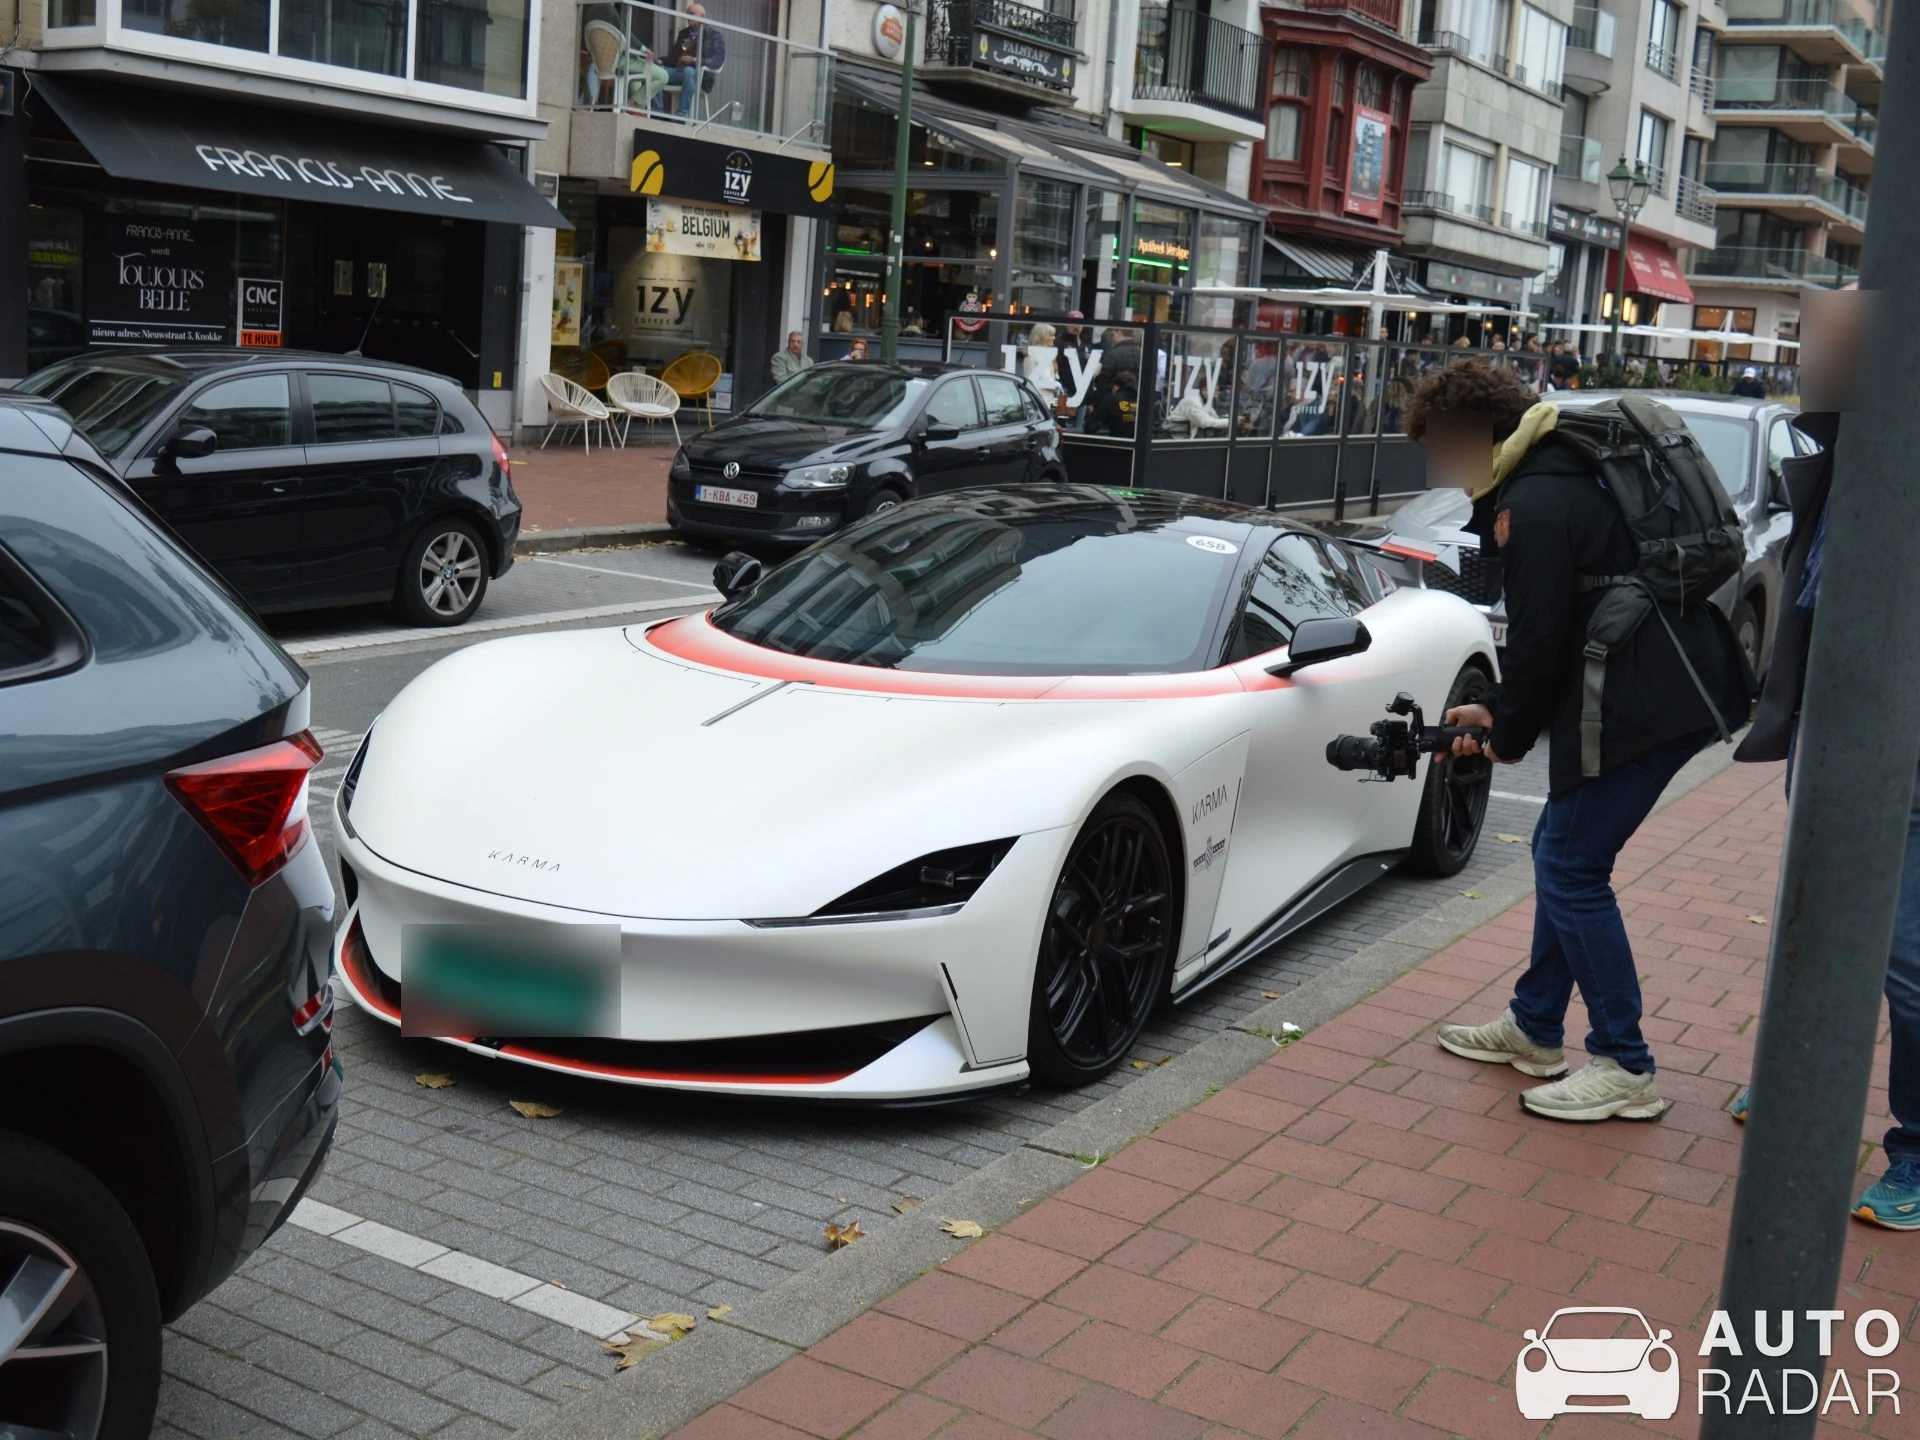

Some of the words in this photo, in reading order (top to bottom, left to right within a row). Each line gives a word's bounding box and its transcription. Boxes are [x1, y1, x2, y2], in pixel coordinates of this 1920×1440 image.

[1003, 40, 1051, 63] FALSTAFF
[196, 145, 473, 203] FRANCIS-ANNE
[126, 225, 194, 242] FRANCIS-ANNE
[682, 216, 730, 239] BELGIUM
[140, 288, 190, 312] BELLE
[246, 286, 278, 305] CNC
[635, 316, 670, 325] COFFEE
[92, 328, 116, 337] nieuw
[117, 329, 141, 338] adres:
[142, 330, 186, 340] Nieuwstraat
[195, 332, 222, 342] Knokke
[243, 333, 252, 344] TE
[255, 334, 278, 345] HUUR
[703, 488, 756, 505] 1-KBA-459
[1196, 540, 1226, 551] 658
[1193, 785, 1228, 825] KARMA
[488, 850, 561, 871] KARMA
